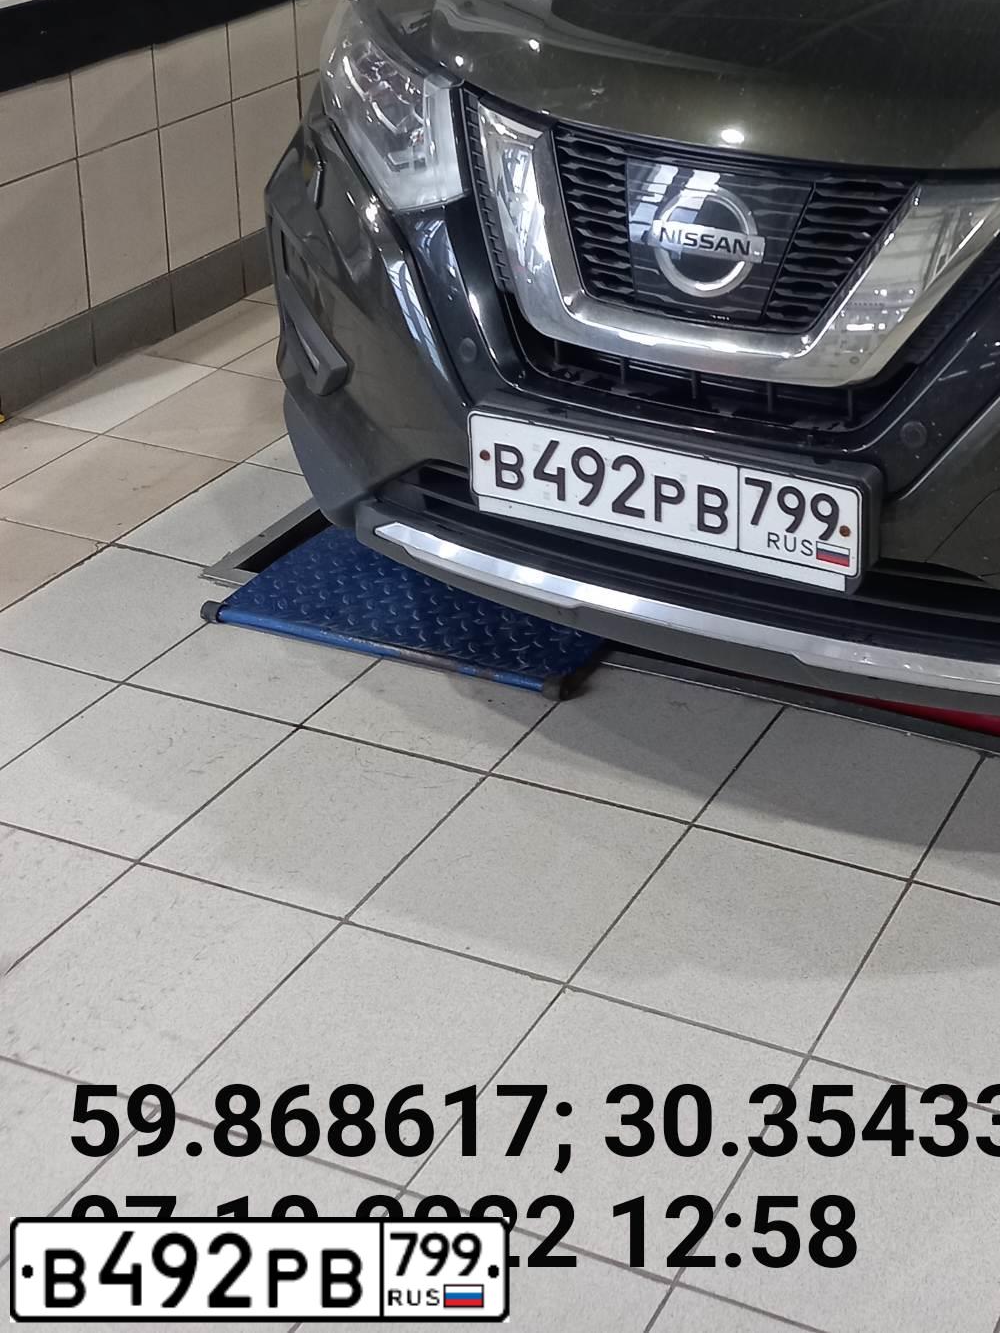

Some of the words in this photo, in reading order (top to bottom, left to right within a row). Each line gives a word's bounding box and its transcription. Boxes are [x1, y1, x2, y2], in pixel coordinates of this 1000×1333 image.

[659, 226, 751, 256] NISSAN
[744, 476, 840, 542] 799
[766, 531, 814, 557] RUS
